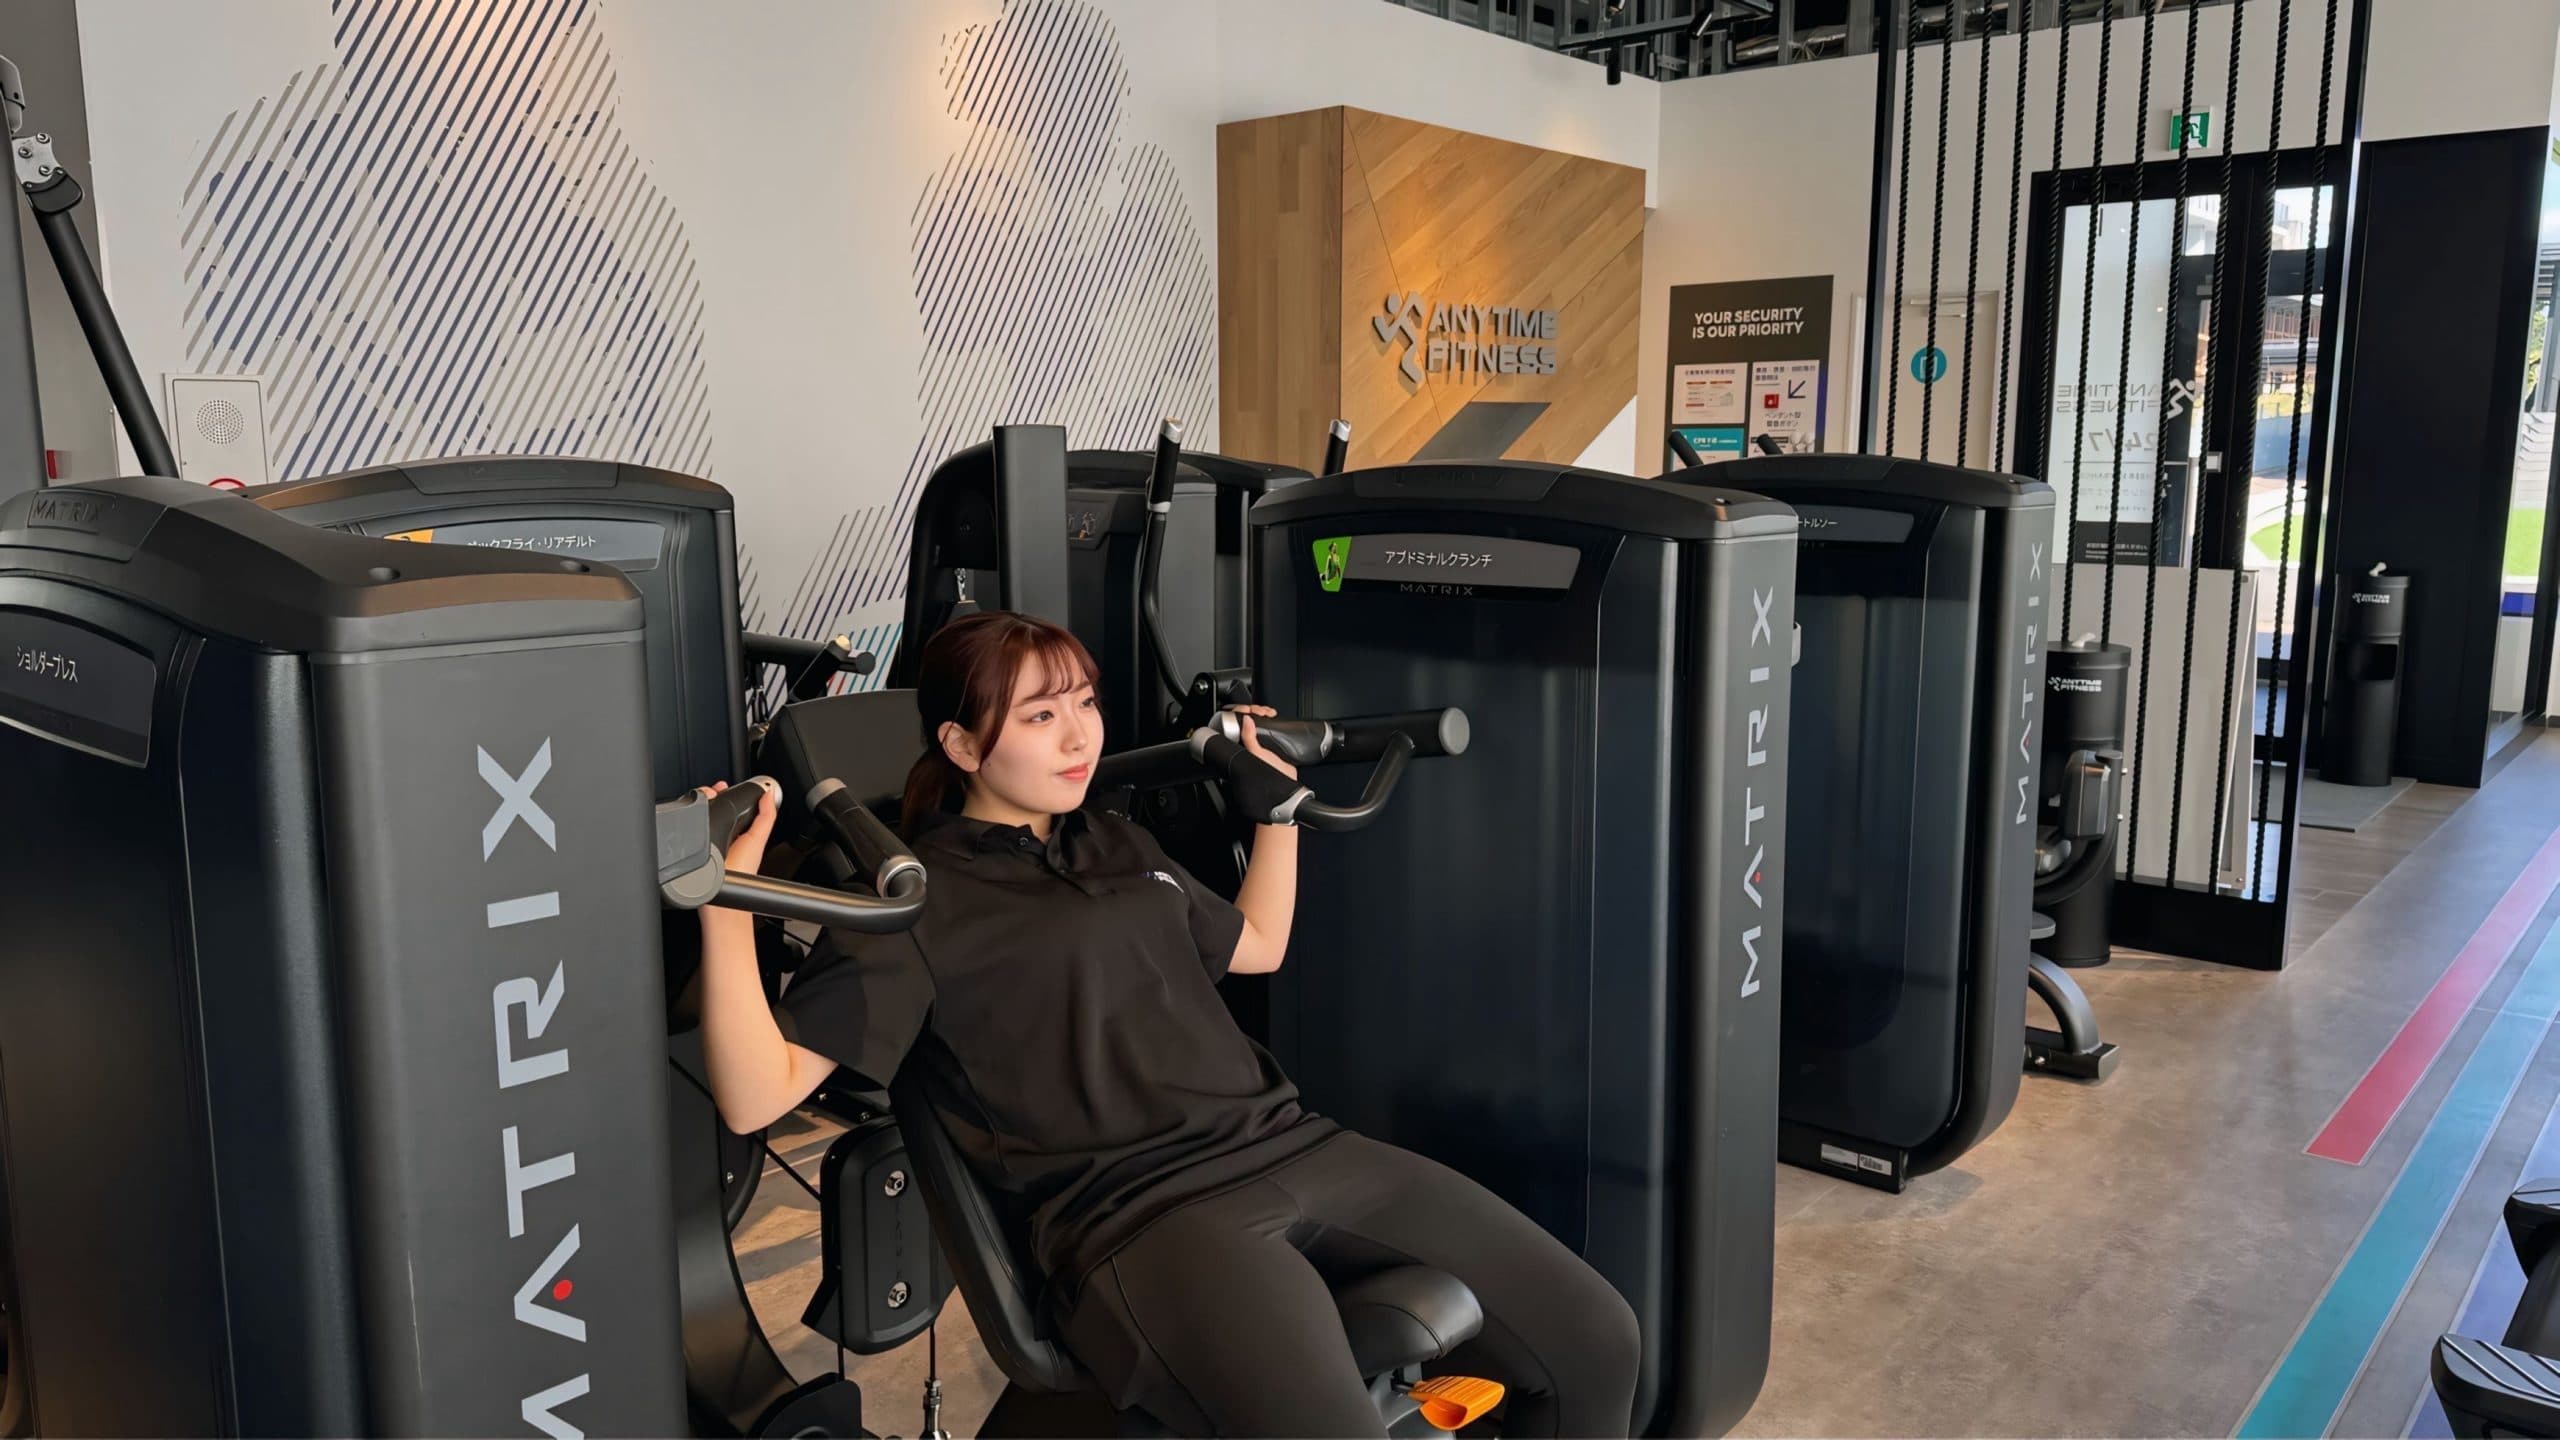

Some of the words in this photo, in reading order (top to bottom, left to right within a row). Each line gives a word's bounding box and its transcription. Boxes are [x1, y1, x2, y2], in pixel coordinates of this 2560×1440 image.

[1428, 303, 1558, 339] ANYTIME
[1692, 326, 1705, 339] IS
[1707, 324, 1736, 338] OUR
[1739, 321, 1804, 337] PRIORITY
[1694, 311, 1732, 325] YOUR
[1735, 307, 1804, 322] SECURITY
[1427, 339, 1557, 374] FITNESS
[33, 501, 99, 523] MATRIX
[1385, 550, 1492, 568] アブドミナルクランチ
[1400, 583, 1473, 596] MATRIX
[16, 646, 79, 683] ショルダープレス
[2016, 543, 2042, 824] MATRIX
[1741, 586, 1773, 998] MATRIX
